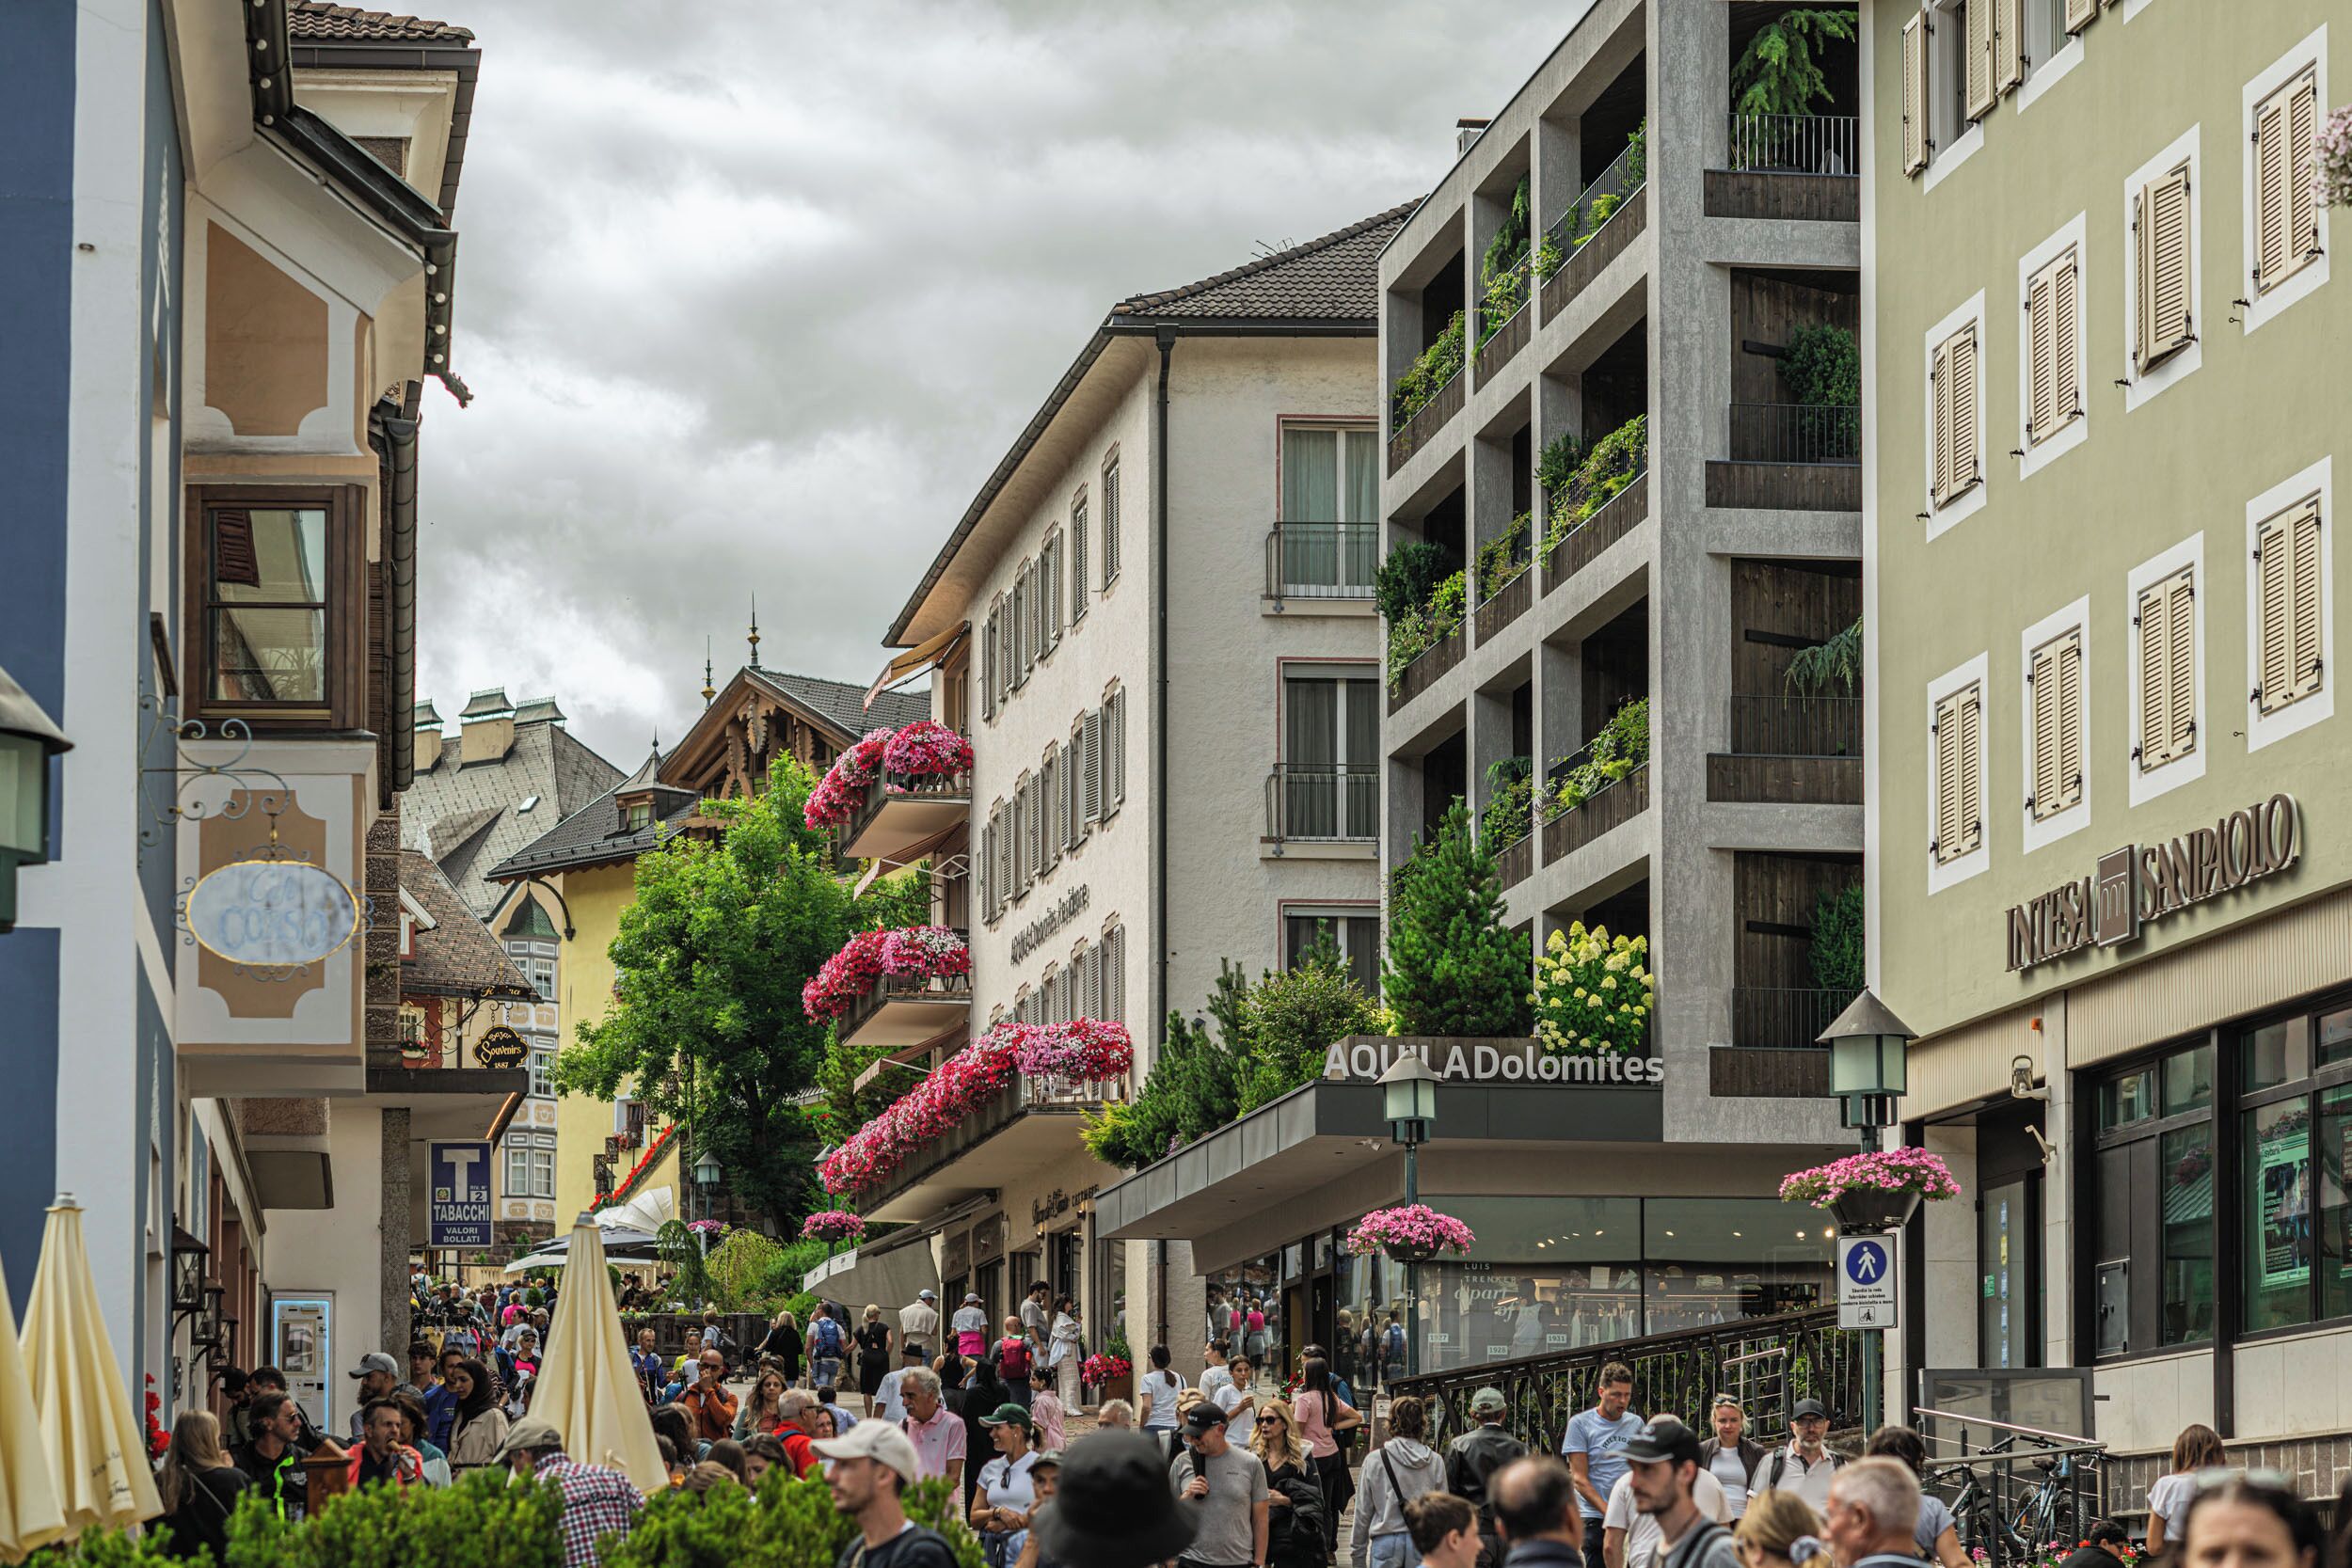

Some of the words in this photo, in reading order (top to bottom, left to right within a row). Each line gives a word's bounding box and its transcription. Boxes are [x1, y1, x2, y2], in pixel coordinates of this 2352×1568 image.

[2005, 876, 2097, 972] INTESA
[2139, 793, 2297, 921] SANPAOLO
[481, 1040, 522, 1063] Souvenirs
[442, 1148, 481, 1202] T
[474, 1191, 484, 1201] 2
[433, 1204, 490, 1222] TABACCHI
[1488, 1346, 1506, 1354] 1928
